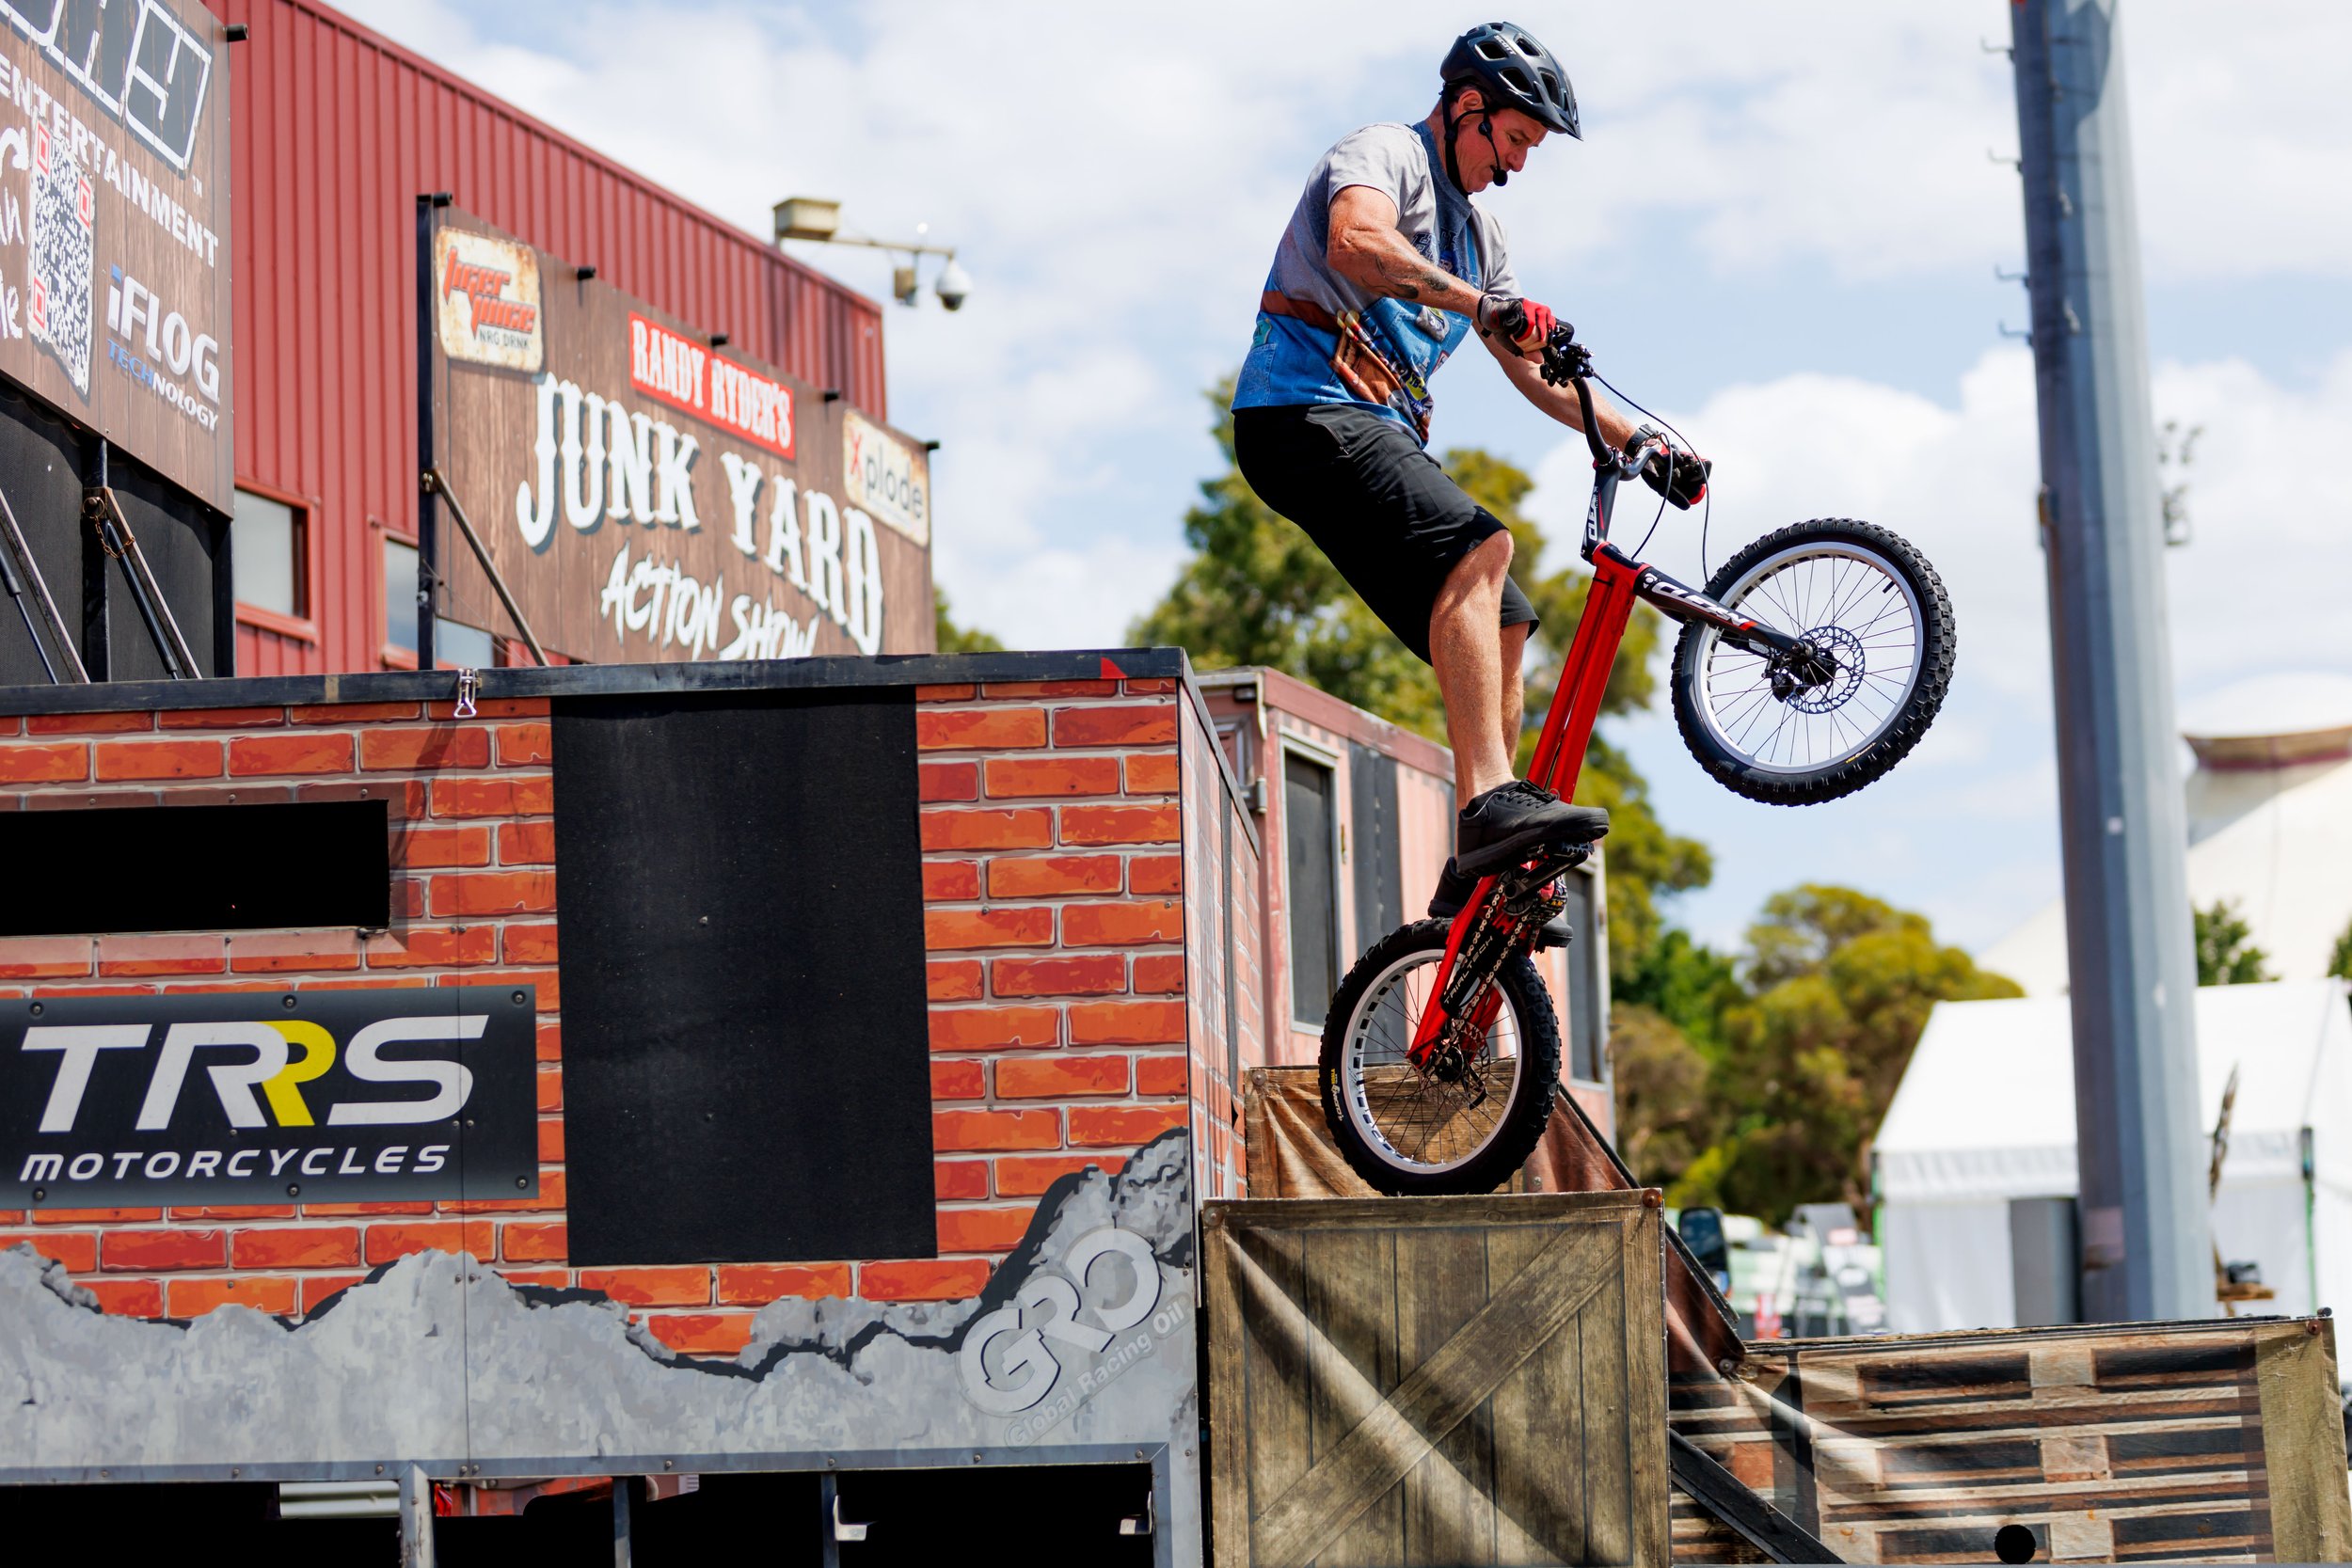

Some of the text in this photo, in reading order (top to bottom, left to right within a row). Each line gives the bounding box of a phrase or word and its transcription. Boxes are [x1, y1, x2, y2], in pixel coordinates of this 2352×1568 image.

[106, 339, 219, 432] TECHNOLOGY
[107, 263, 220, 405] iFLOG
[479, 329, 501, 346] NRG
[632, 320, 792, 450] RANDY RYDER'S
[516, 372, 883, 656] JUNK YARD
[601, 538, 820, 661] ACTION SHOW
[20, 1145, 451, 1182] MOTORCYCLES
[1007, 1300, 1185, 1448] Global Racing Oil
